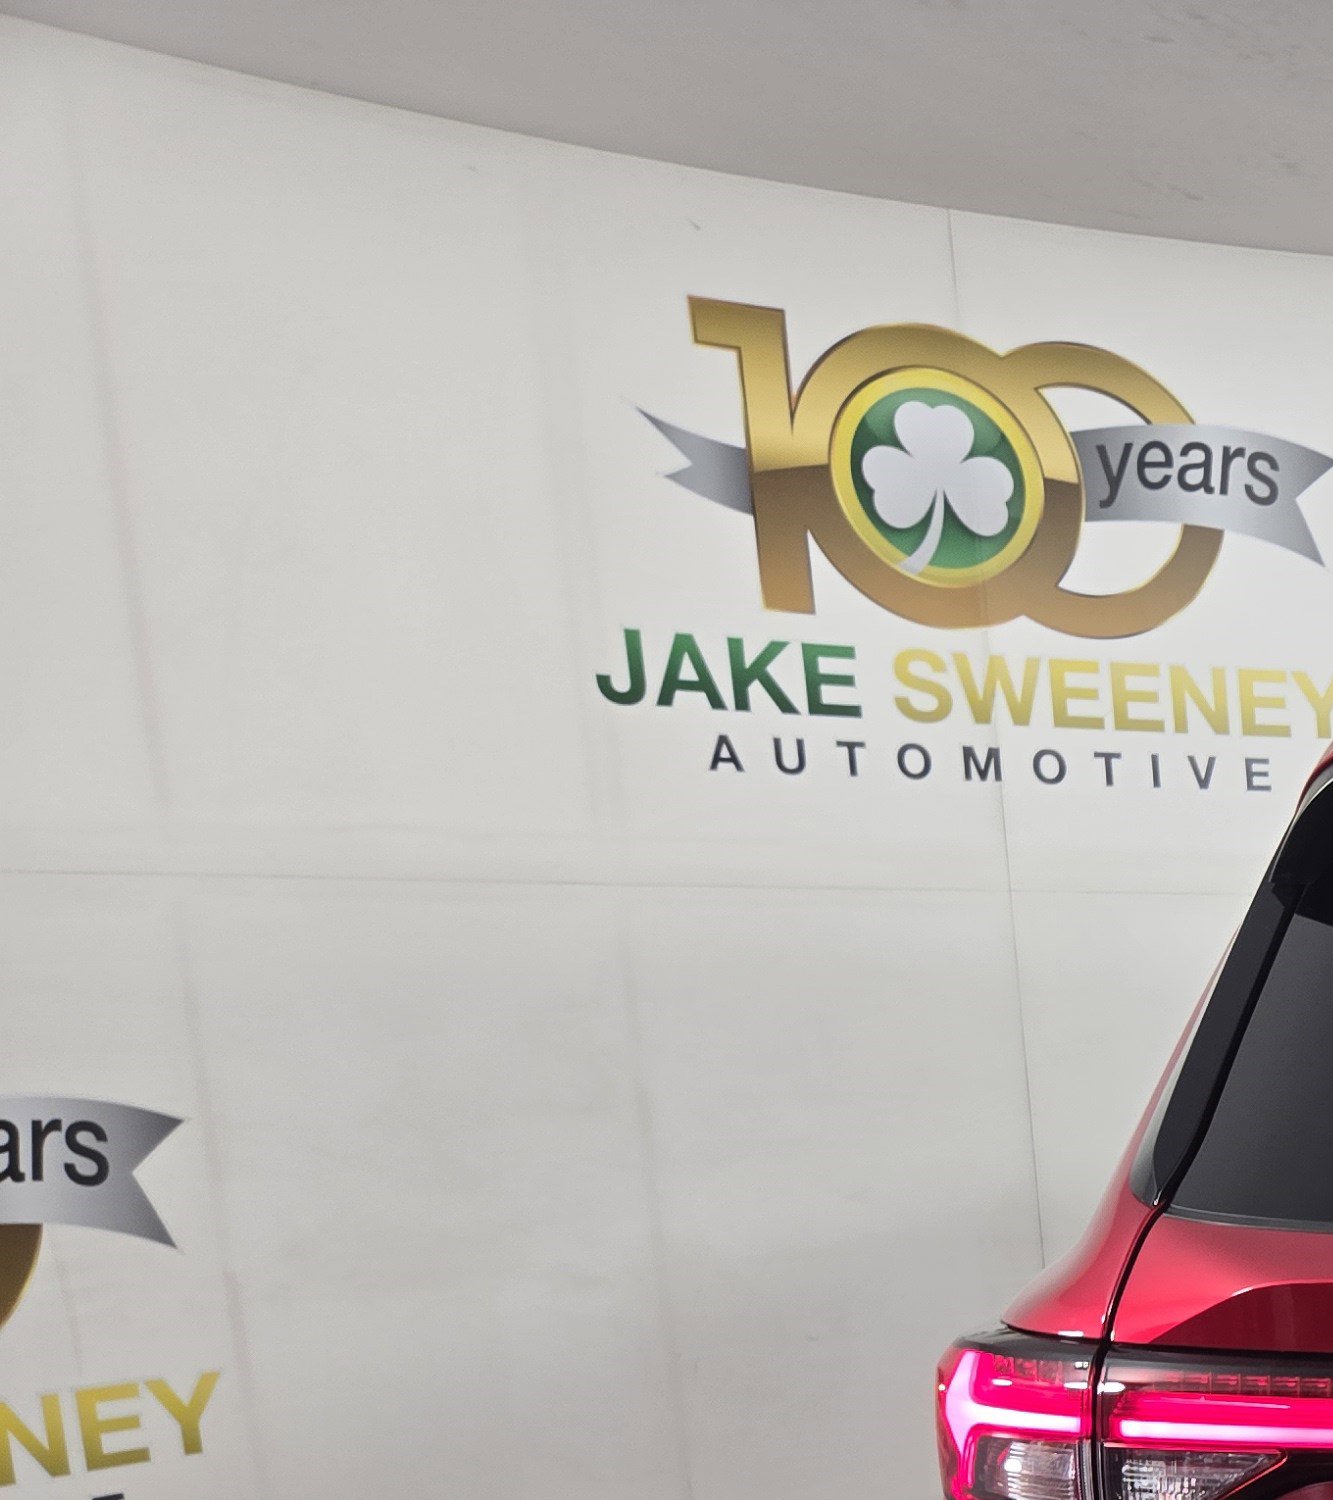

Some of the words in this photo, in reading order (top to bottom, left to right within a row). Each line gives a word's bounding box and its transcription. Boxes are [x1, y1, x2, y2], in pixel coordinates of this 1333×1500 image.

[687, 294, 1225, 639] 100
[1096, 436, 1281, 508] years
[595, 628, 863, 719] JAKE
[709, 733, 1273, 792] AUTOMOTIVE
